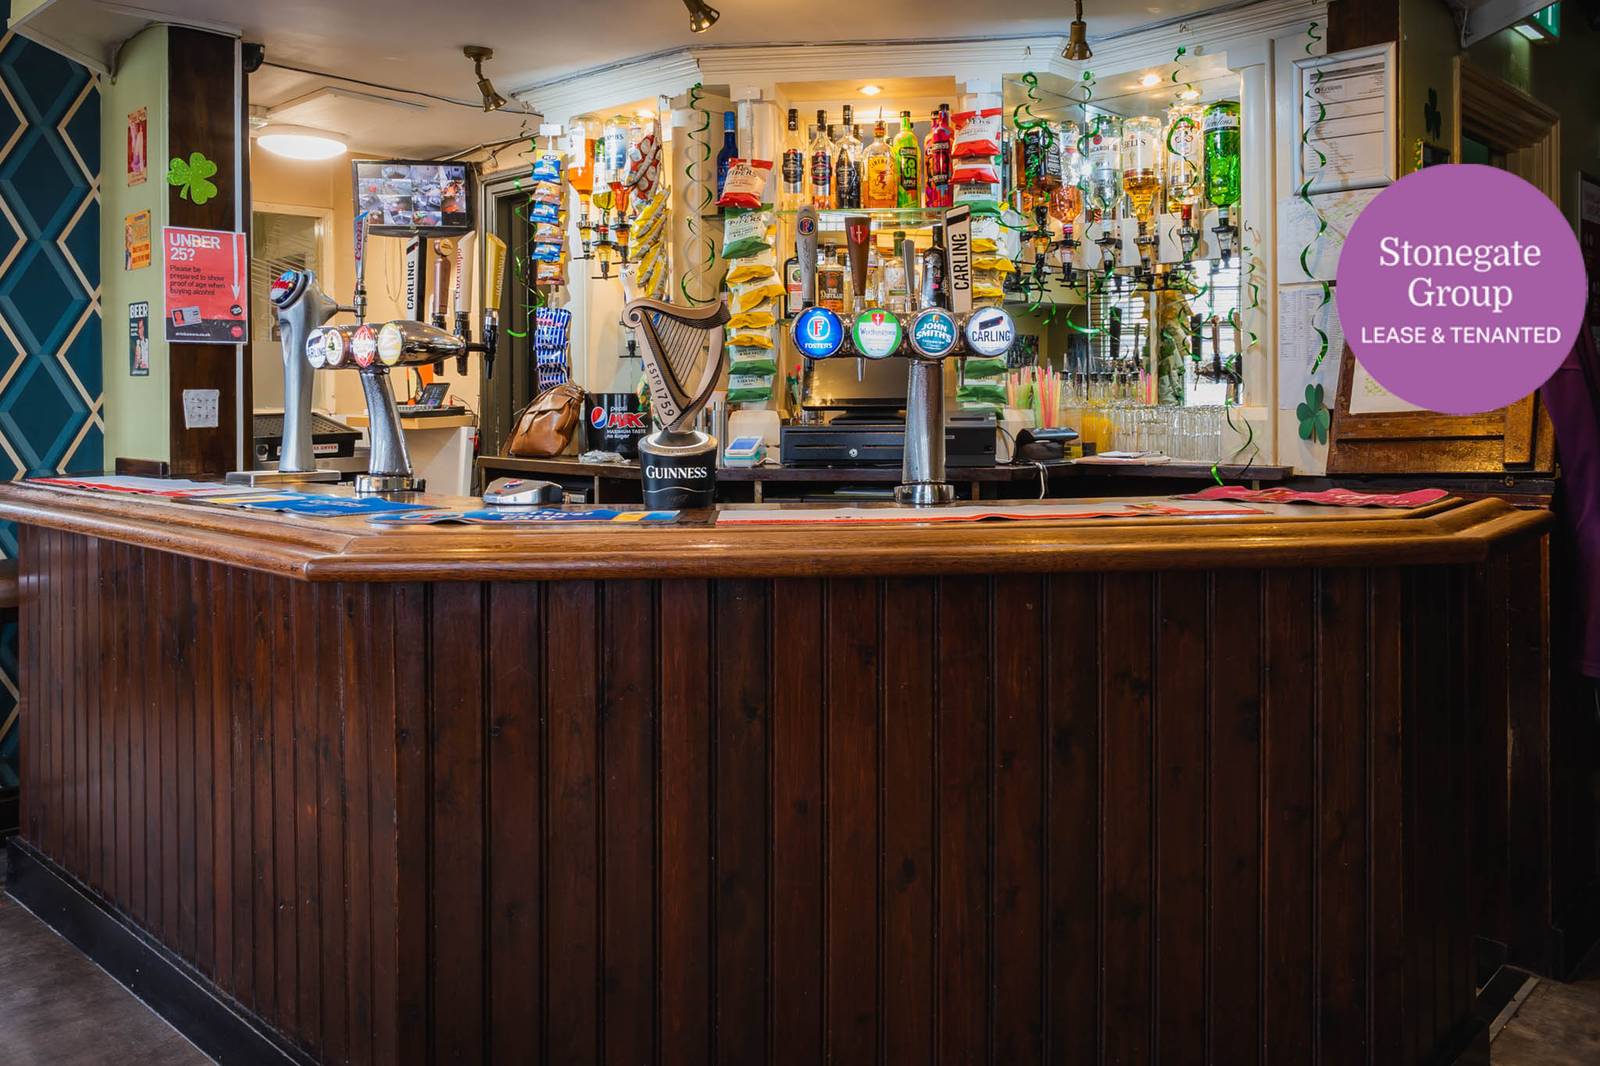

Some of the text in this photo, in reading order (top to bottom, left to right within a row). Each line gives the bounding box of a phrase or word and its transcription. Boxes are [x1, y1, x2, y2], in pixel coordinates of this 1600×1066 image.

[169, 233, 221, 249] UNDER
[169, 247, 196, 261] 25?
[951, 232, 970, 291] CARLING
[169, 264, 192, 272] Please
[406, 260, 415, 310] CARLING
[130, 303, 149, 319] BEER
[920, 322, 948, 332] JOHN
[915, 329, 952, 343] SMITH'S
[971, 330, 1011, 342] CARLING
[655, 387, 675, 417] 1759
[607, 412, 648, 429] MAX
[645, 465, 708, 479] GUINNESS
